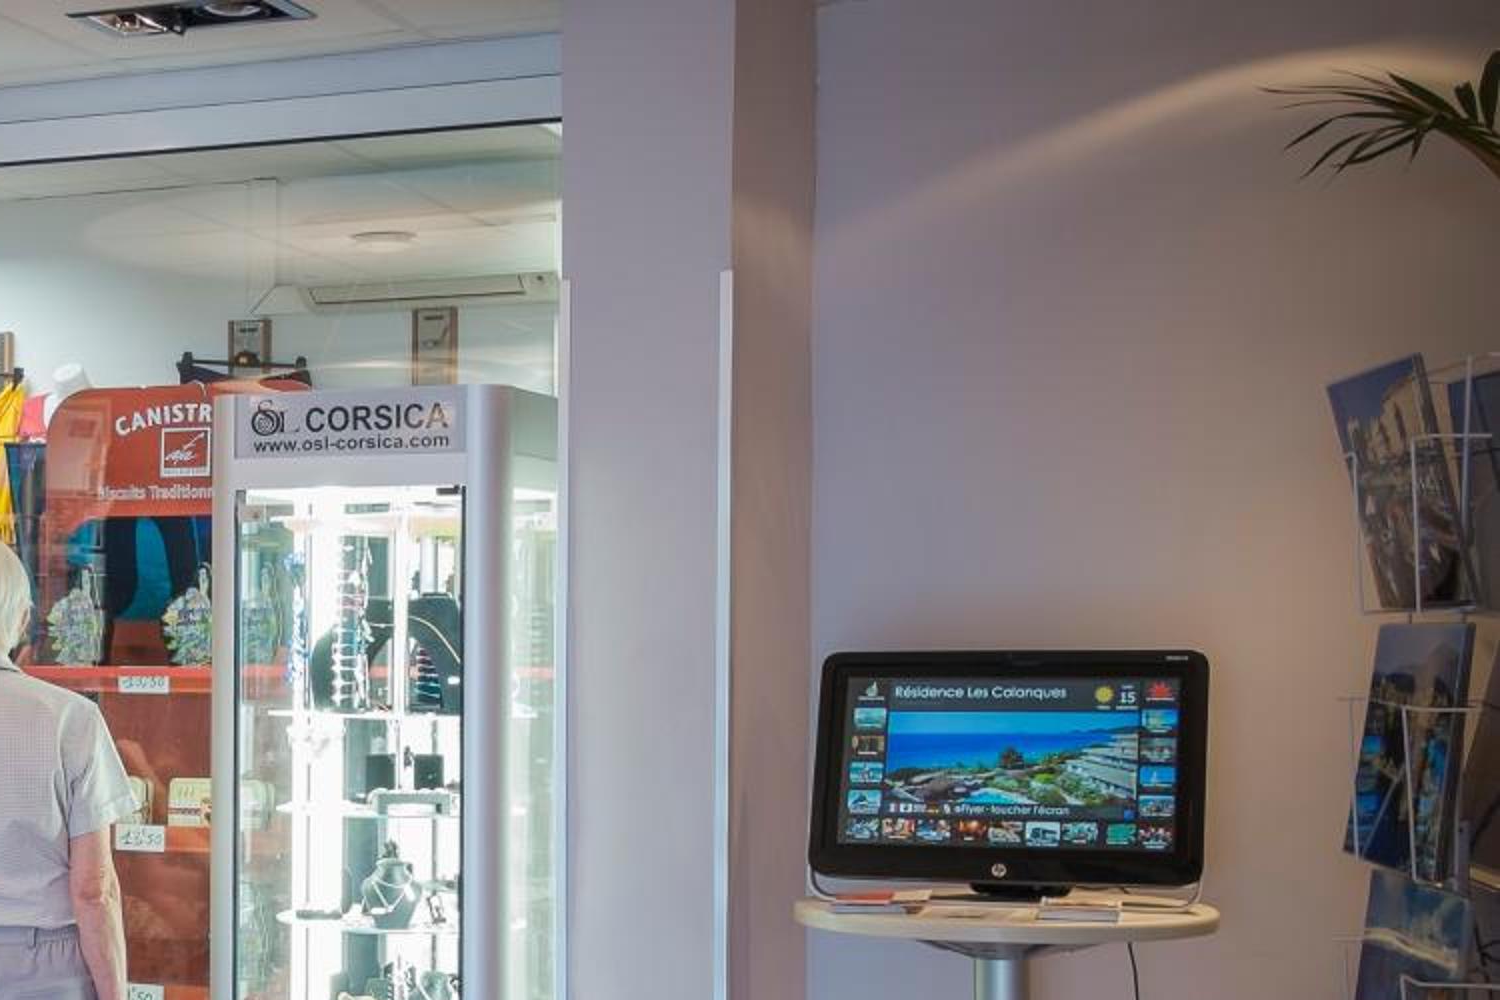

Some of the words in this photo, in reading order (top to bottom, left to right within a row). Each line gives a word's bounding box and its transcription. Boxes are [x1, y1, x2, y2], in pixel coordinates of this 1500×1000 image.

[115, 403, 212, 436] CANISTR
[306, 403, 449, 432] CORSICA
[253, 434, 449, 452] www.osl-corsica.com
[895, 685, 964, 698] Résidence
[967, 686, 989, 698] Les
